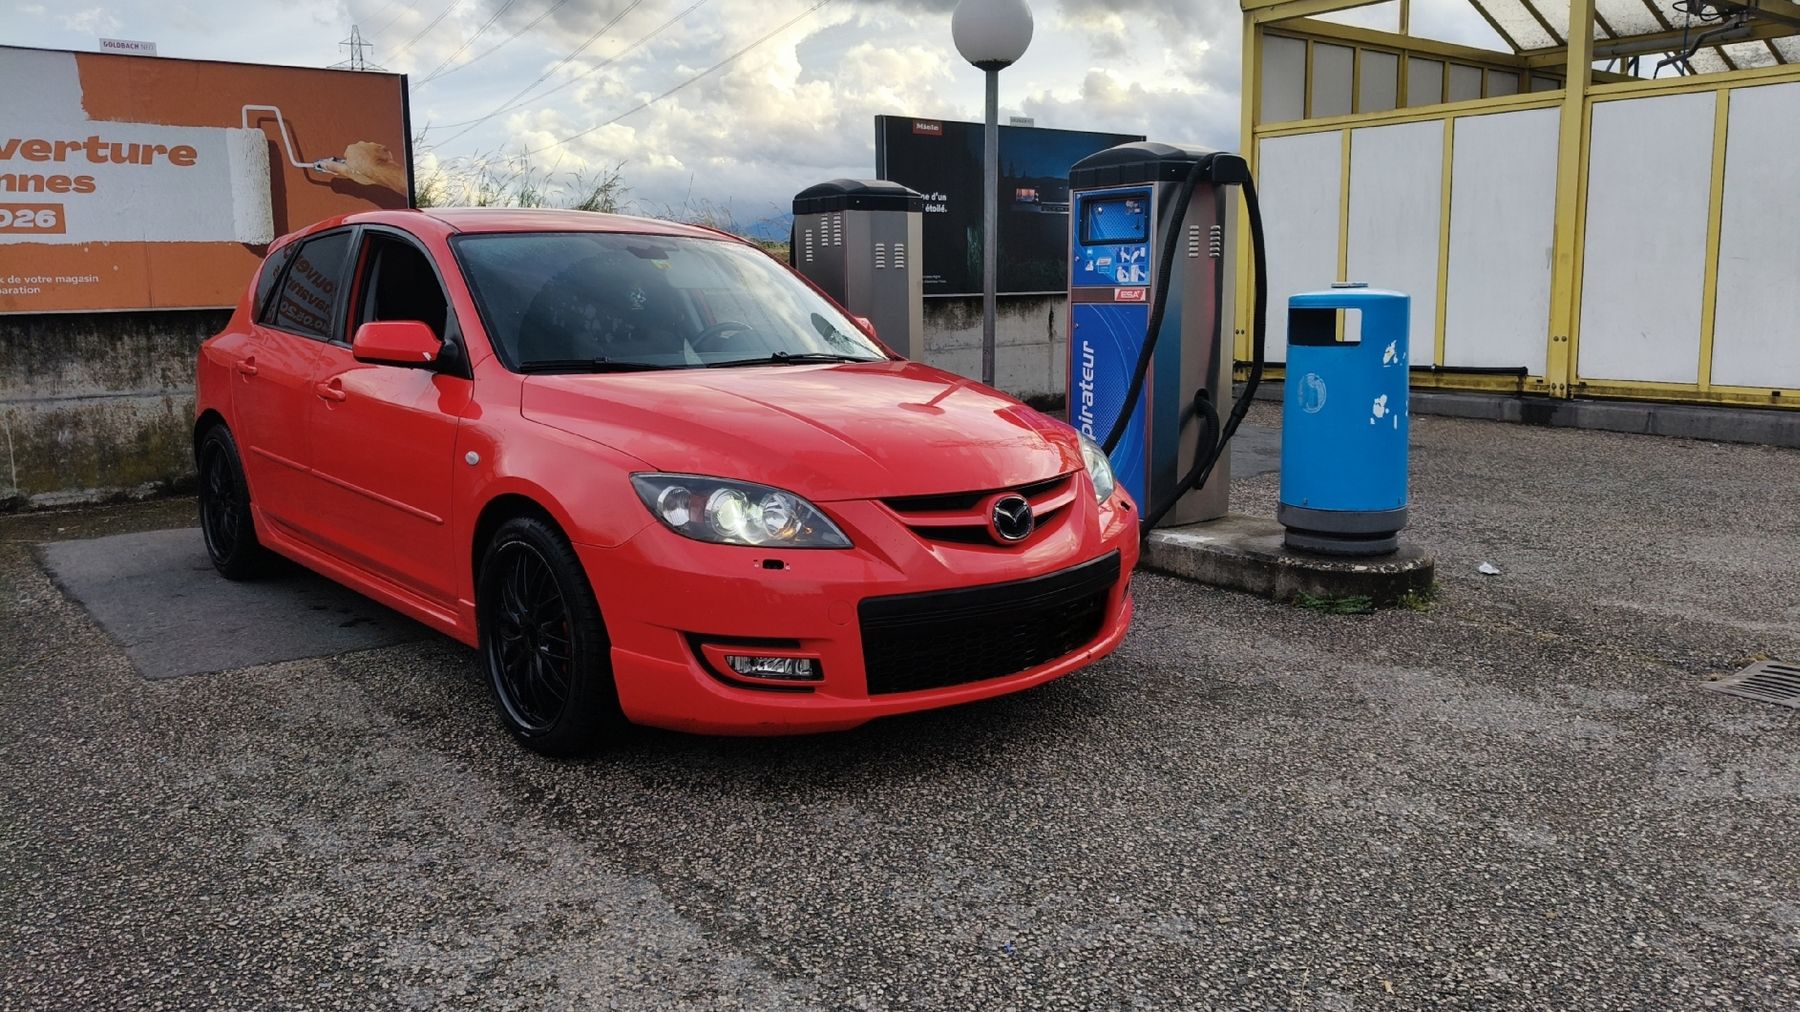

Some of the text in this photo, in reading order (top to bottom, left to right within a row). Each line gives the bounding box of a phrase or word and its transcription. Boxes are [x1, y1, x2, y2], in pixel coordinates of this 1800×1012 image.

[103, 41, 139, 50] GOLDBACH
[916, 122, 939, 131] Miele
[0, 135, 198, 167] verture
[931, 192, 947, 201] d'un
[925, 203, 948, 213] étoilé.
[7, 275, 21, 284] de
[24, 276, 53, 284] votre
[55, 275, 99, 284] magasin
[0, 286, 40, 295] aration
[1120, 290, 1141, 299] ESA
[1078, 340, 1096, 440] pirateur
